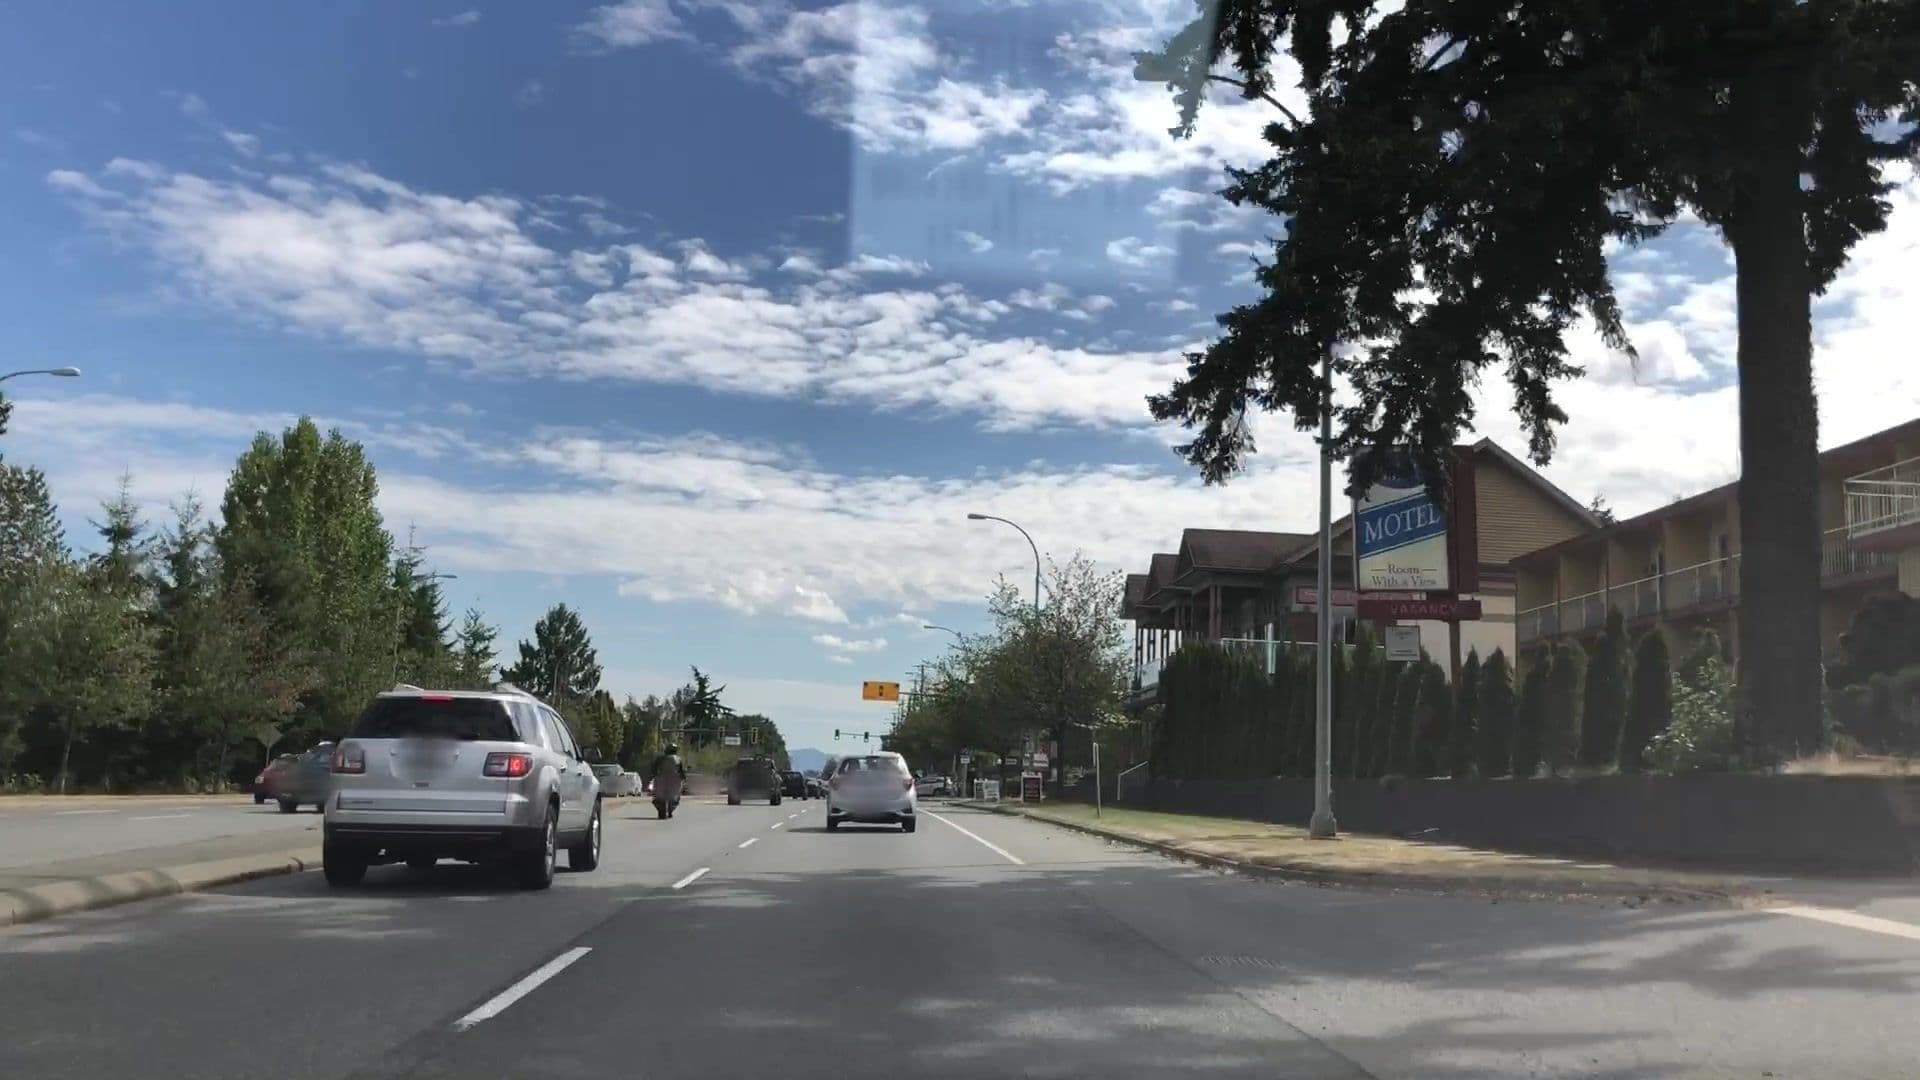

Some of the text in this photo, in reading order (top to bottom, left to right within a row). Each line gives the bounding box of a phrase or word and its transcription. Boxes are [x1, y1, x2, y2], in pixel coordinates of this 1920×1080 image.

[1364, 503, 1441, 544] MOTEL
[1388, 564, 1420, 575] Room
[1371, 576, 1398, 587] With
[1410, 576, 1437, 587] View
[1391, 603, 1457, 616] VACANCY
